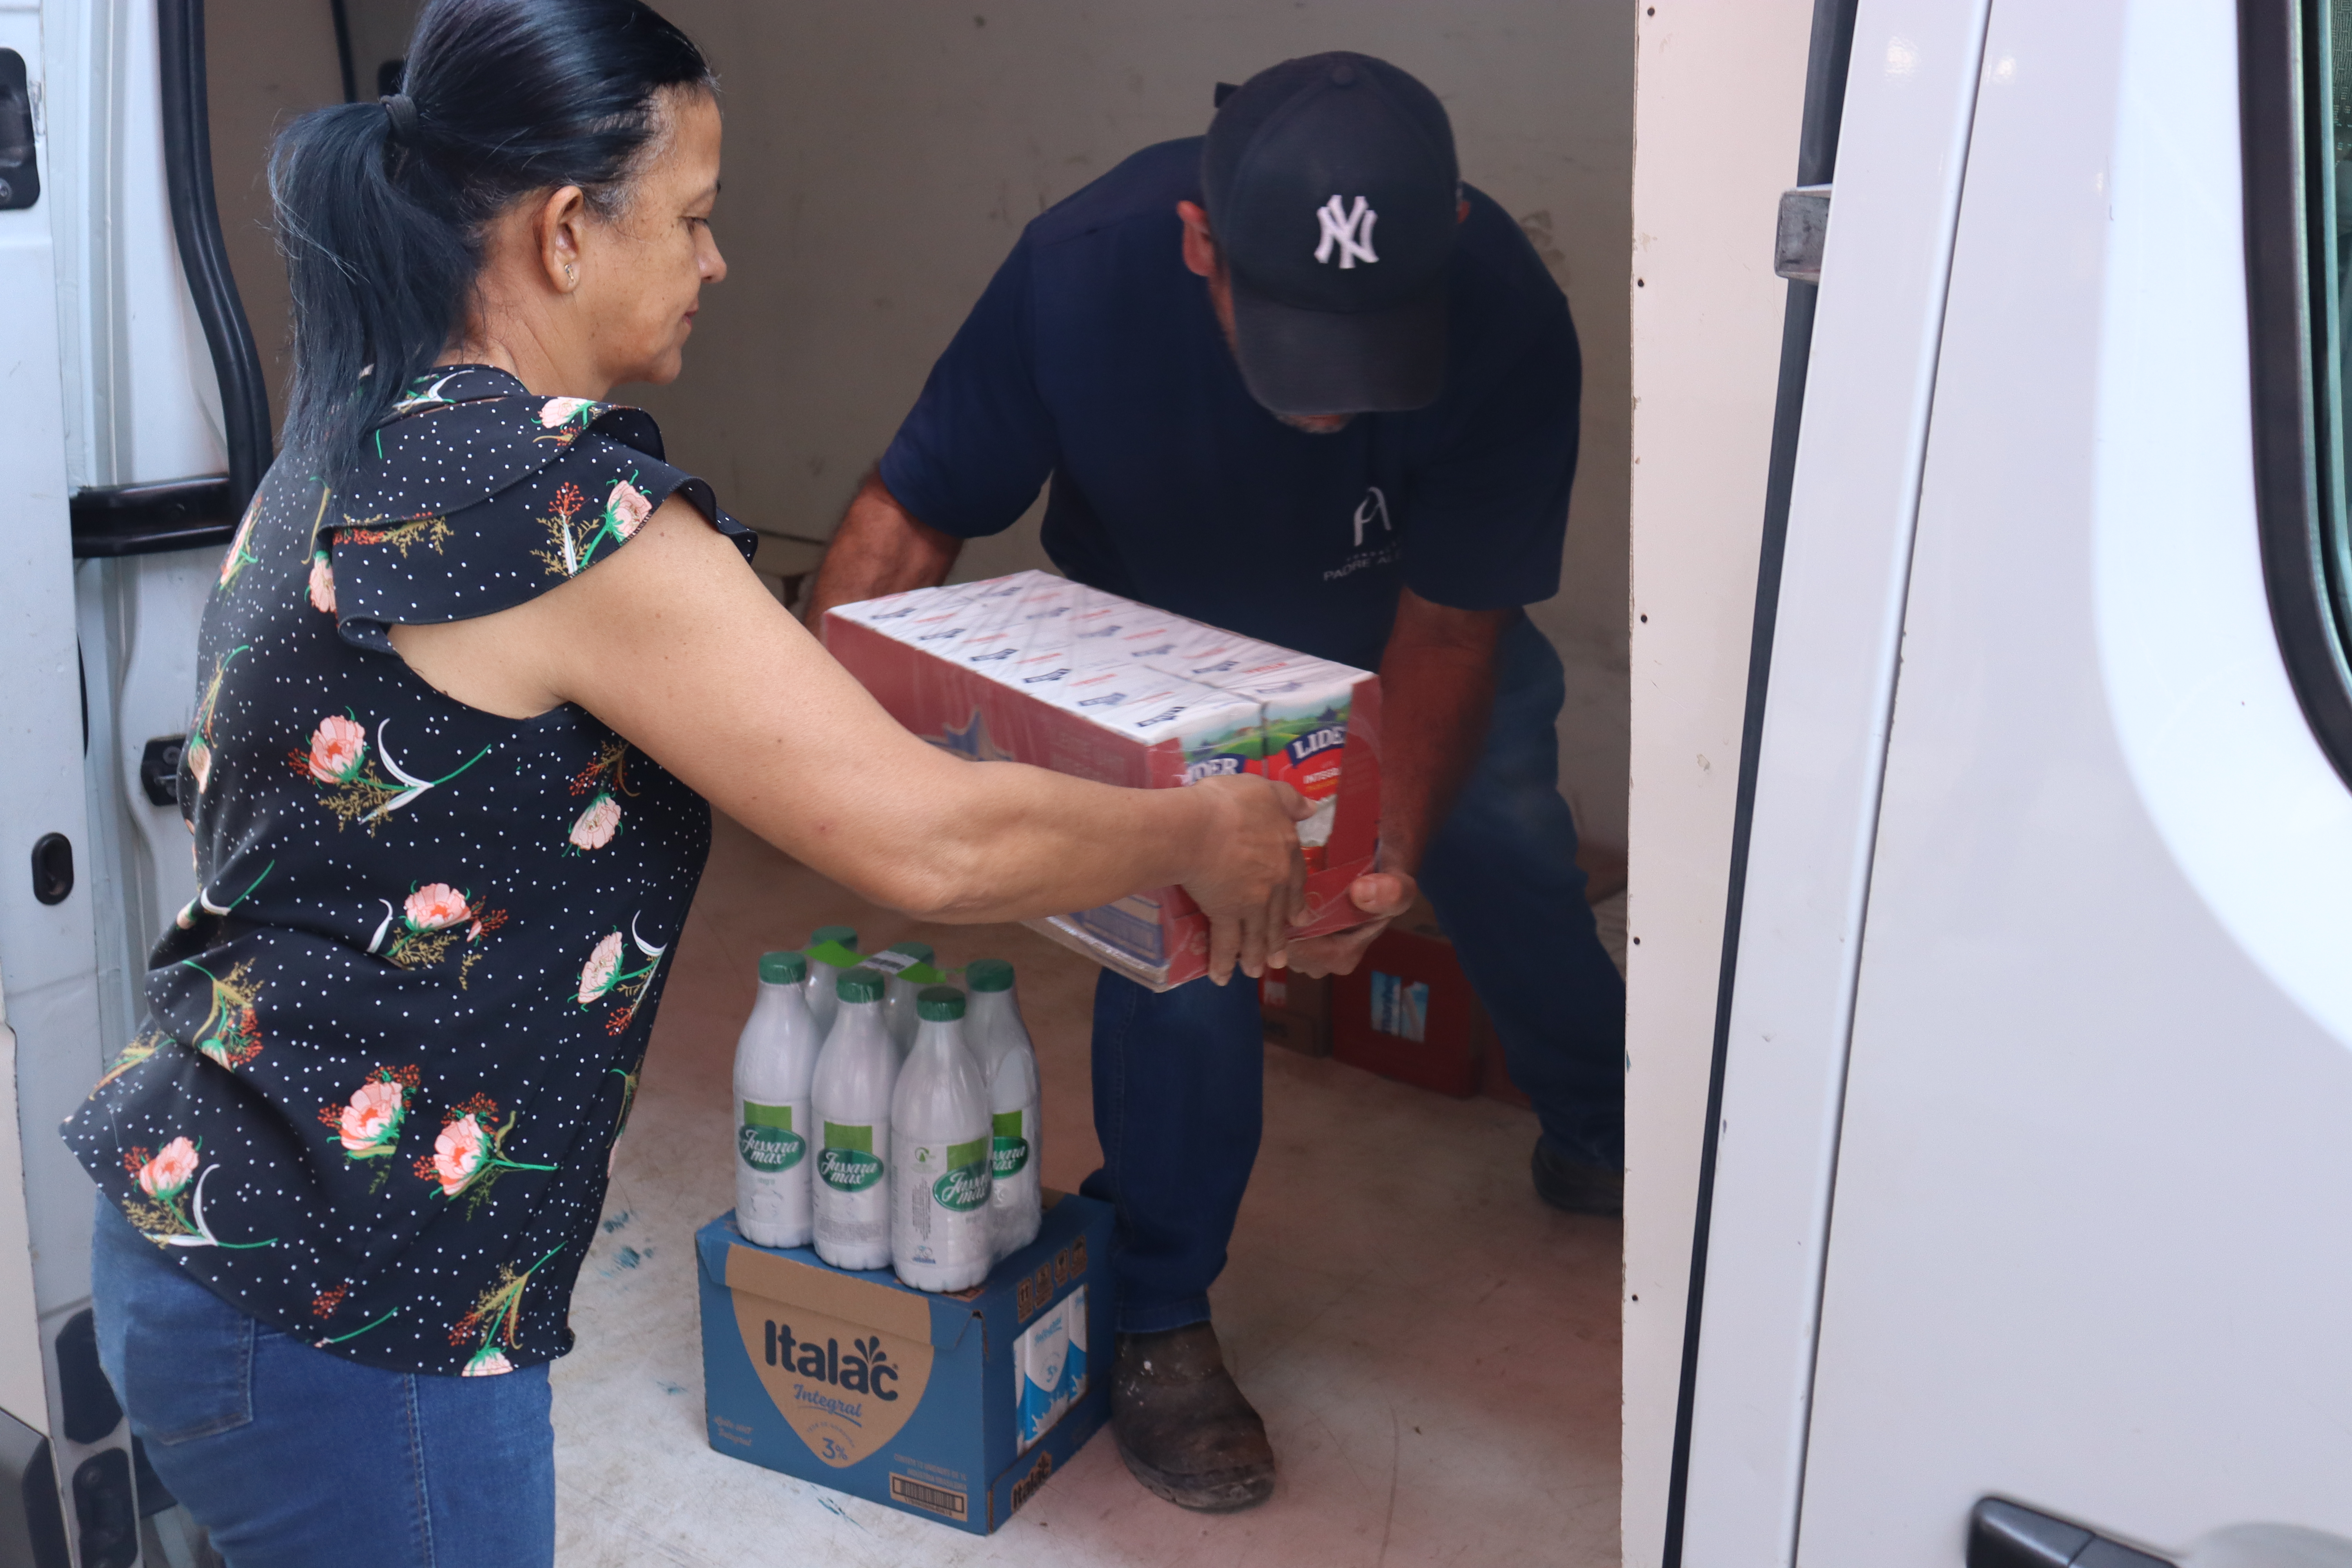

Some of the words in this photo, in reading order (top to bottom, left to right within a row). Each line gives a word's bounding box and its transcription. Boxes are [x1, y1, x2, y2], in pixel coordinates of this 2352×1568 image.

[1314, 194, 1379, 269] NY
[1292, 726, 1347, 759] LIDE
[742, 1129, 800, 1156] Jussara
[750, 1151, 786, 1165] max
[821, 1151, 878, 1178] Jussara
[829, 1172, 864, 1184] max
[765, 1319, 898, 1401] Italac
[793, 1384, 862, 1417] Integral
[822, 1437, 848, 1461] 3%
